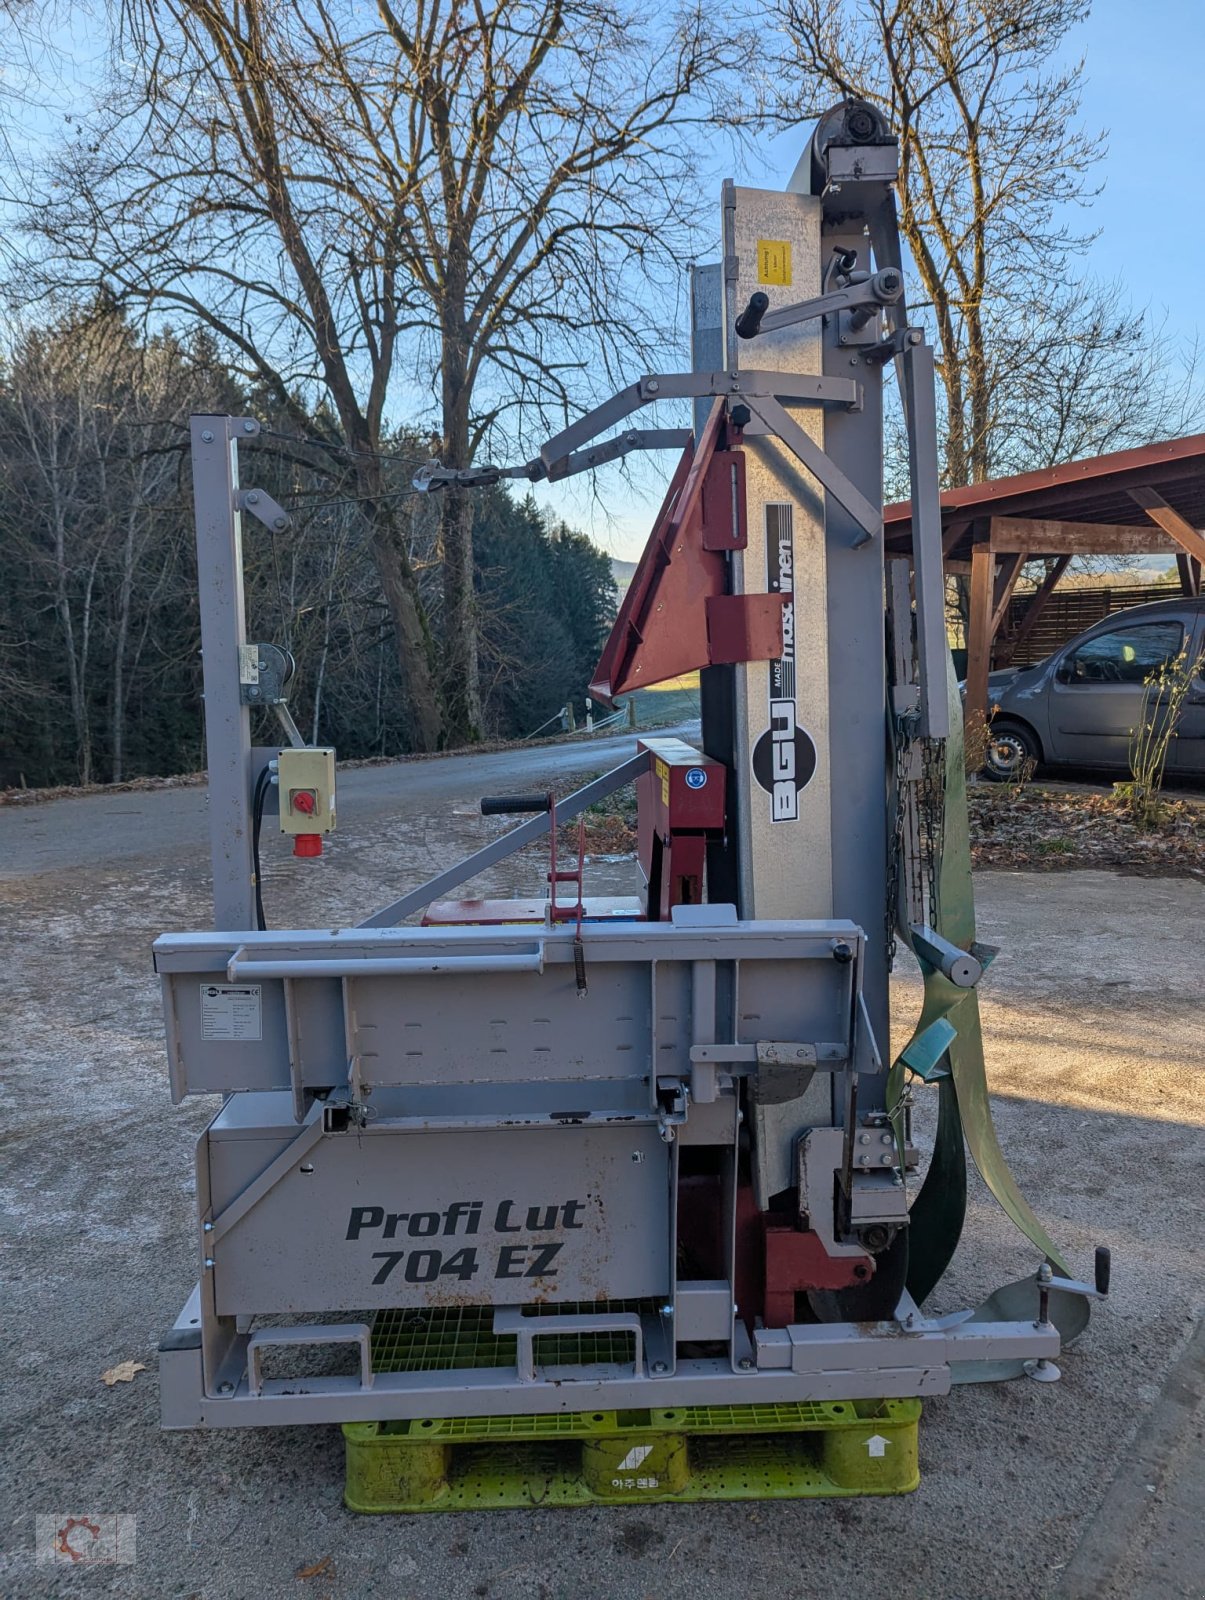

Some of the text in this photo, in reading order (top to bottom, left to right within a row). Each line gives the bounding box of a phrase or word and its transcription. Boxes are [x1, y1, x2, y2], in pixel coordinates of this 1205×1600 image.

[773, 540, 794, 662] mascinen
[773, 703, 796, 820] BGU
[345, 1200, 483, 1240] Profi
[372, 1242, 565, 1286] 704 EZ
